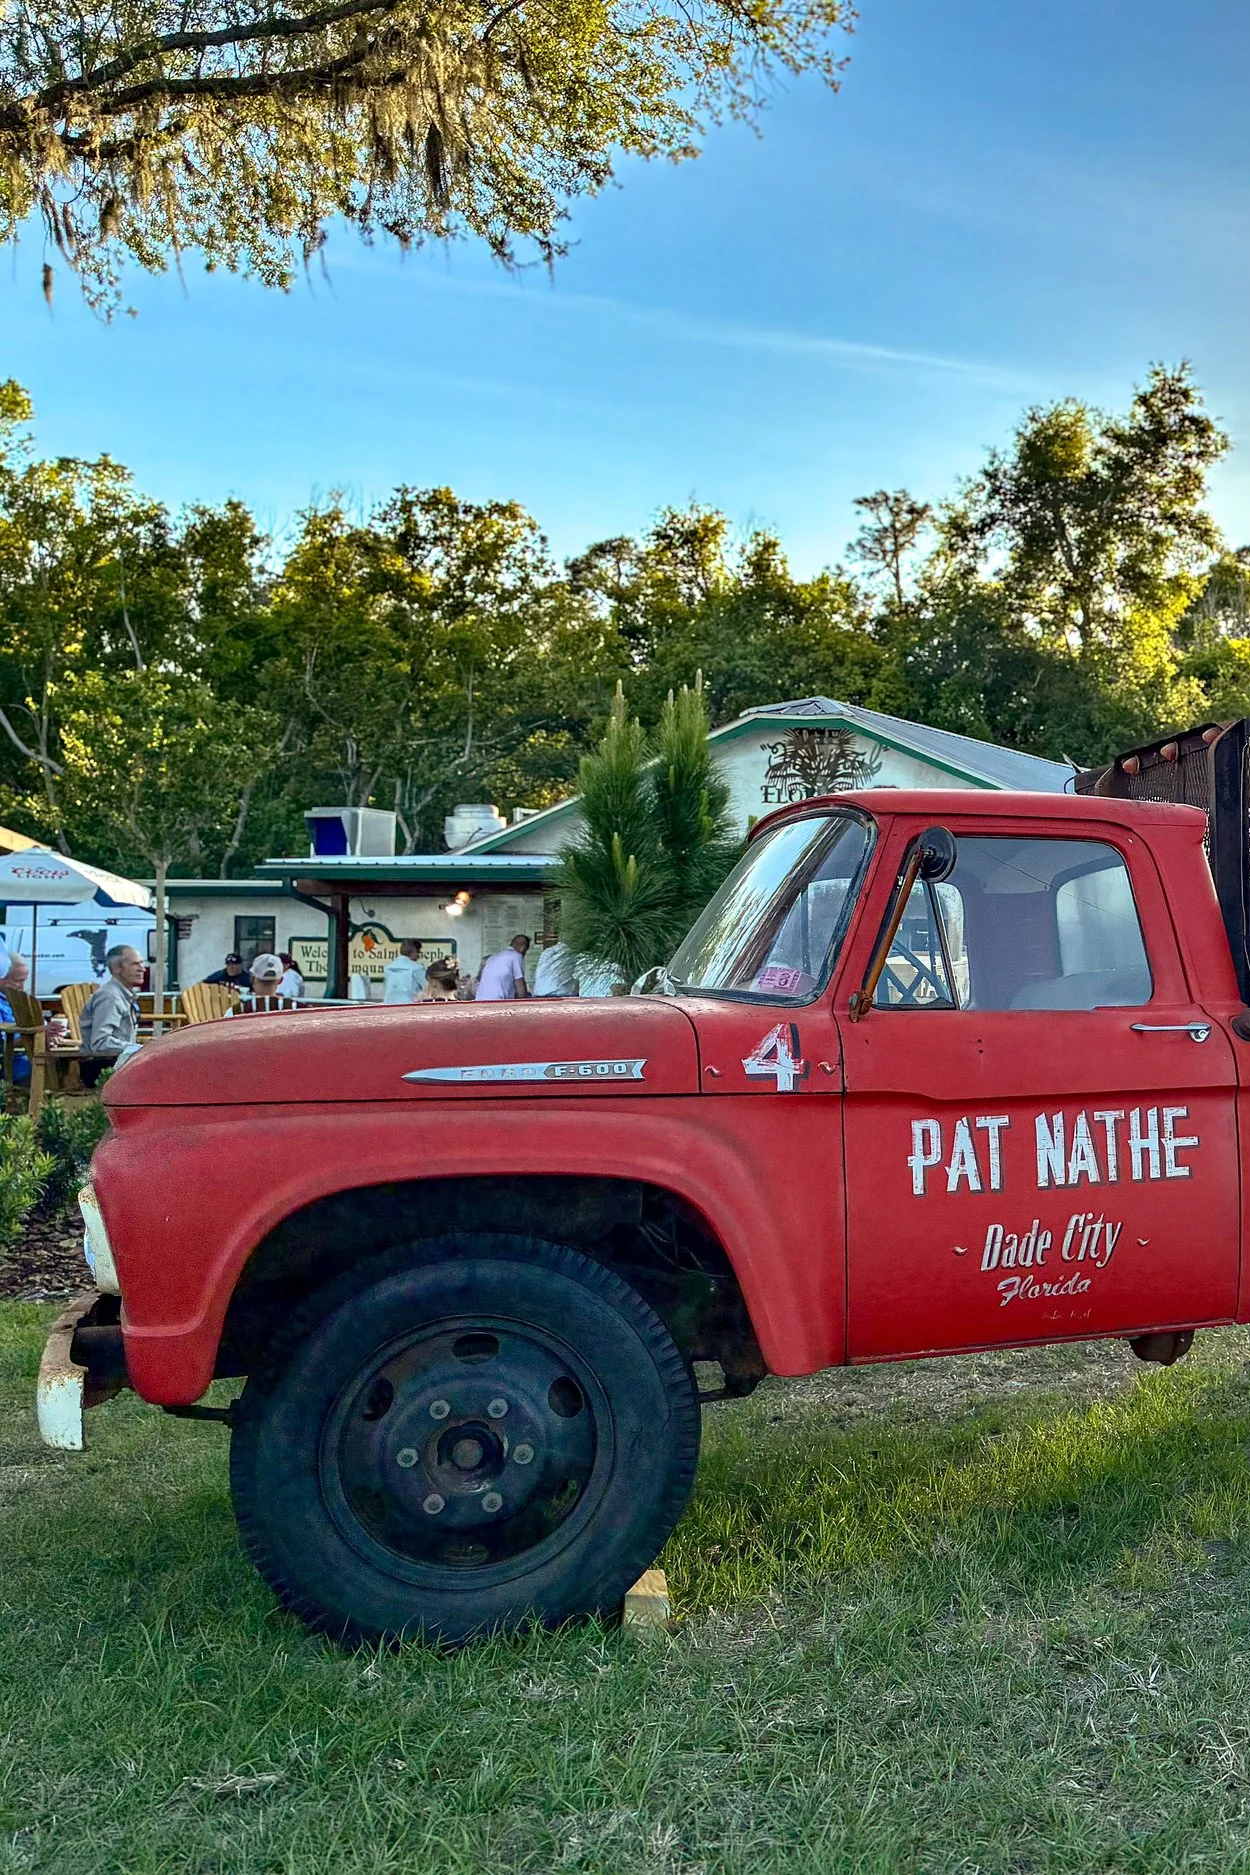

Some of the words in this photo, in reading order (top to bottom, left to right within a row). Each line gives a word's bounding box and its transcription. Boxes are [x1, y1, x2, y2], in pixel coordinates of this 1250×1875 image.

[301, 945, 328, 959] Welc
[353, 947, 364, 960] to
[368, 947, 398, 960] Saint
[554, 1063, 628, 1077] F-600
[741, 1023, 806, 1092] 4
[907, 1114, 1010, 1195] PAT
[1034, 1106, 1200, 1188] NATHE
[980, 1219, 1052, 1271] Dade
[1061, 1212, 1122, 1268] City
[997, 1272, 1092, 1307] Florida
